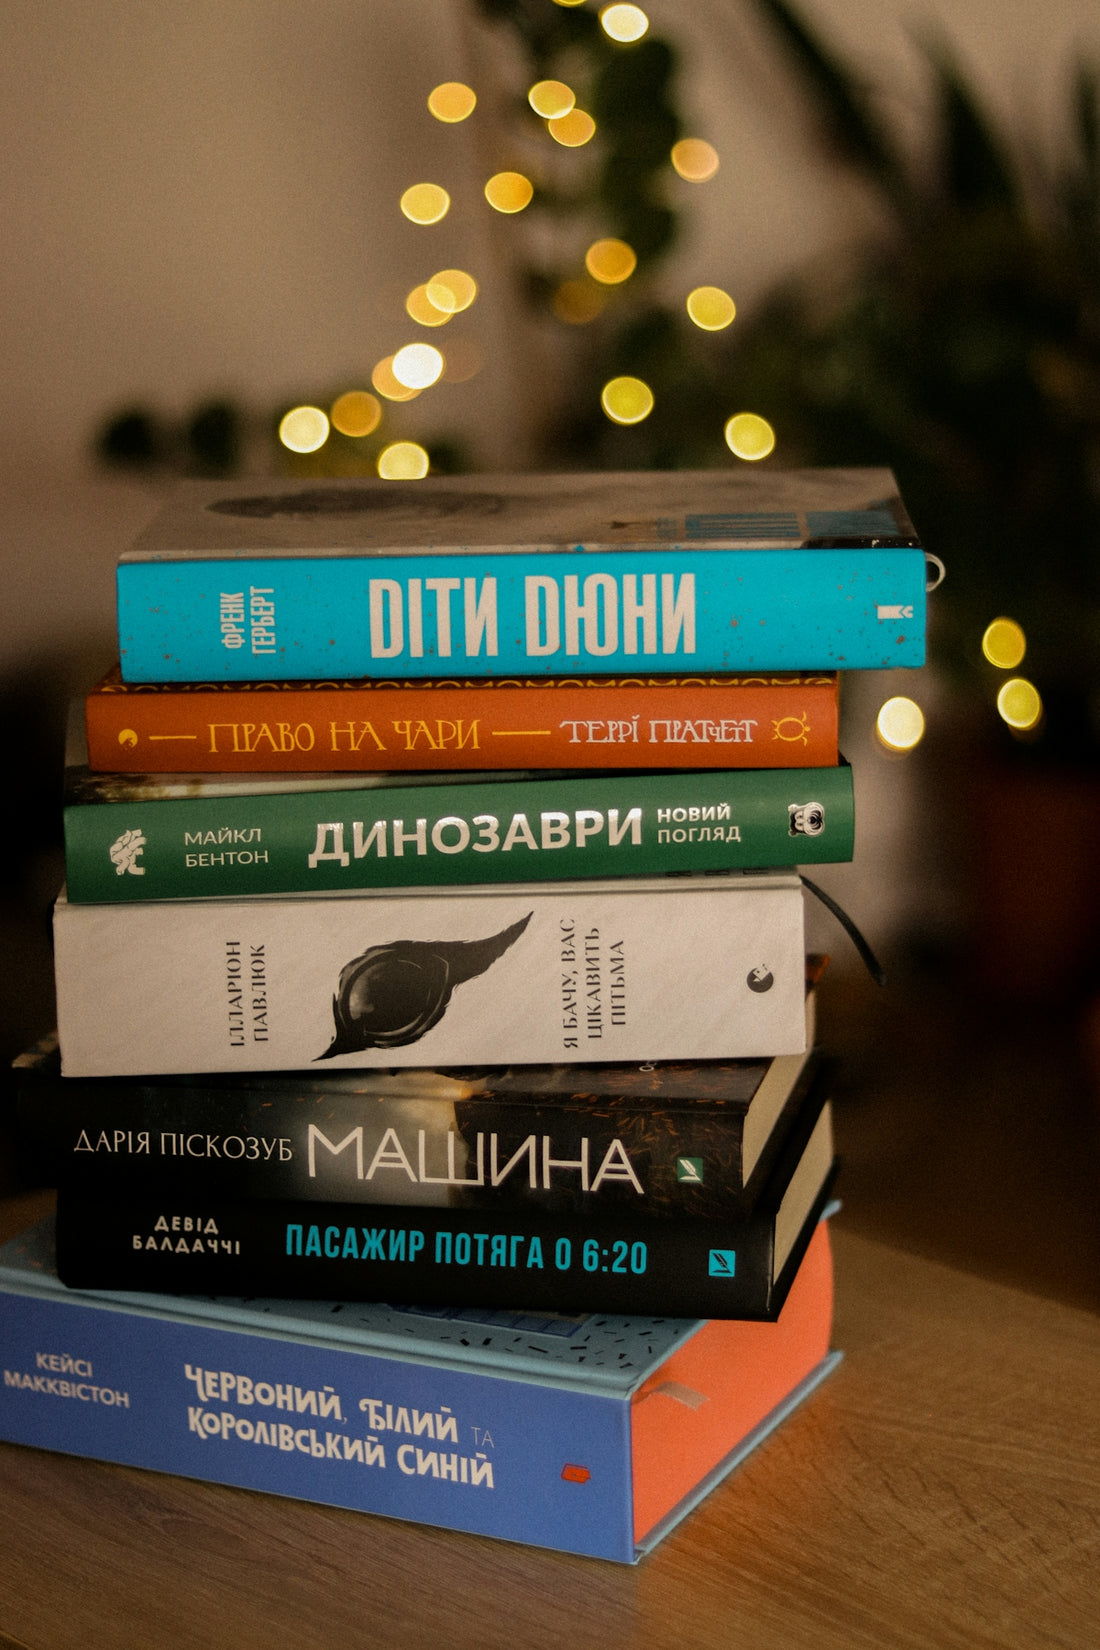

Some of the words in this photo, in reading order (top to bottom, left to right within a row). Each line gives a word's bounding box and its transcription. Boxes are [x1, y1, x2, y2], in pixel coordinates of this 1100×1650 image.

[220, 591, 246, 650] ФРЕНК
[249, 585, 276, 655] ГЕРБЕРТ
[369, 577, 498, 658] ДІТИ
[524, 573, 696, 657] ДЮНИ
[208, 722, 315, 753] ПРАВО
[330, 721, 388, 751] НА
[392, 718, 482, 752] ЧАРИ
[648, 719, 759, 743] ПРАТЧЕТТ
[184, 826, 262, 847] МАЙКЛ
[657, 802, 731, 824] НОВИЙ
[657, 824, 742, 844] ПОГЛЯД
[185, 849, 269, 868] БЕНТОН
[308, 806, 643, 869] ДИНОЗАВРИ
[559, 918, 577, 962] ВАС
[226, 941, 245, 1047] ІЛЛАРІОН
[250, 944, 269, 1042] ПАВЛЮК
[561, 970, 579, 1029] БАЧУ,
[584, 927, 605, 1039] ЦІКАВИТЬ
[609, 939, 627, 1026] ПІТЬМА
[562, 1037, 579, 1049] Я
[73, 1129, 151, 1155] ДАРІЯ
[160, 1132, 293, 1162] ПІСКОЗУБ
[307, 1123, 645, 1195] МАШИНА
[132, 1235, 240, 1256] БАЛДАЧЧІ
[154, 1215, 219, 1235] ДЕВІД
[286, 1224, 425, 1263] ПАСАЖИР
[435, 1230, 544, 1270] ПОТЯГА
[582, 1240, 648, 1275] 6:20
[35, 1352, 94, 1378] КЕЙСІ
[3, 1370, 130, 1409] МАККВІСТОН
[184, 1363, 348, 1425] ЧЕРВОНИЙ,
[359, 1398, 459, 1443] БІЛИЙ
[470, 1425, 496, 1449] ТА
[187, 1406, 386, 1469] КОРОЛІВСЬКИЙ
[397, 1444, 495, 1489] СИНІЙ
